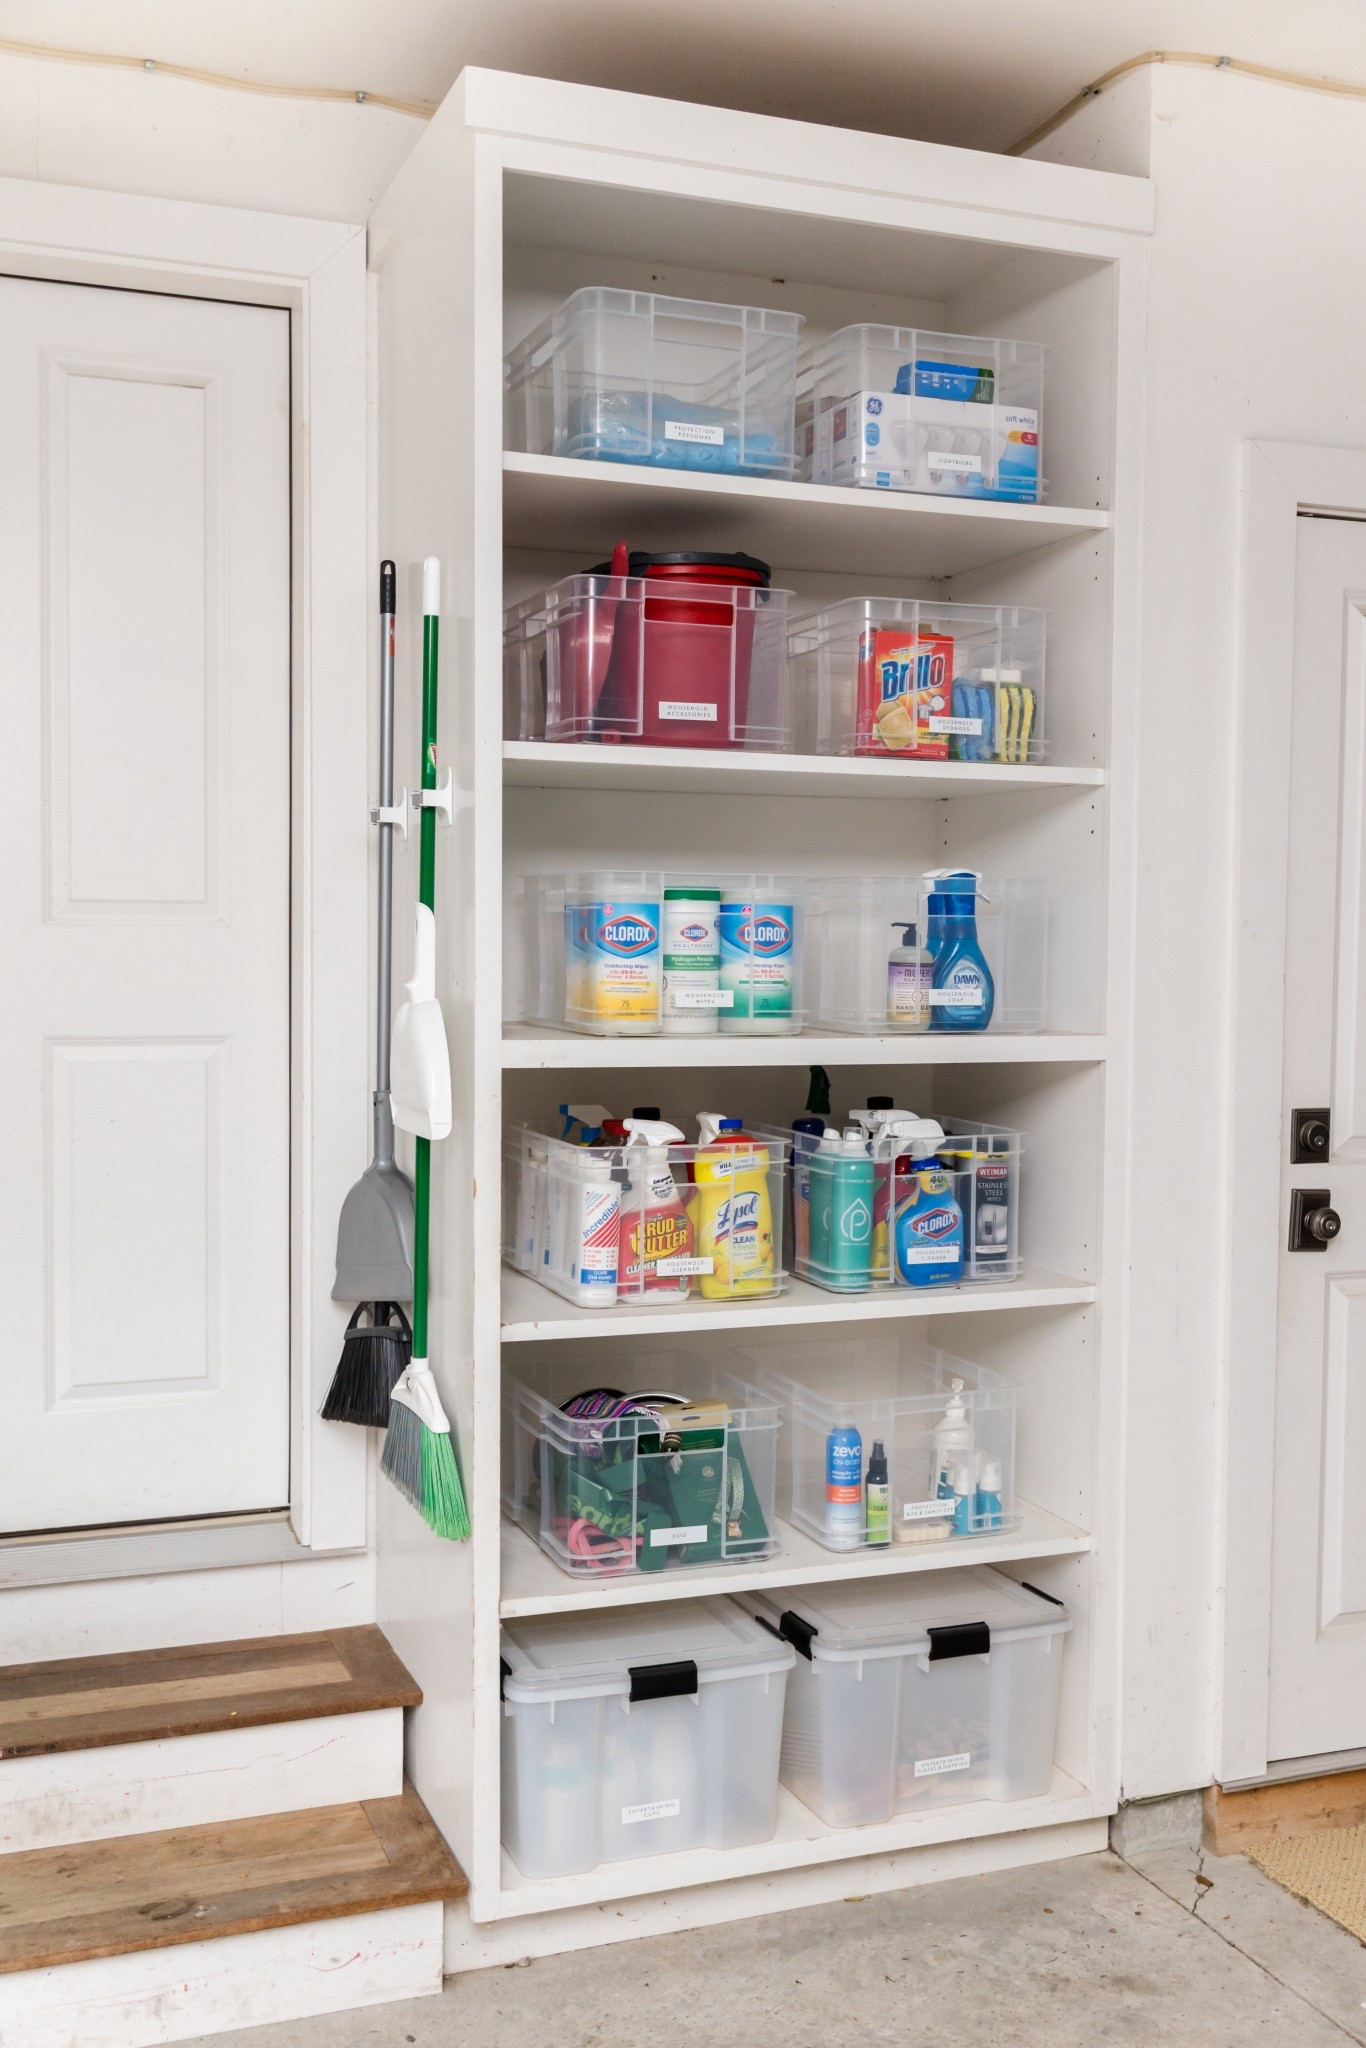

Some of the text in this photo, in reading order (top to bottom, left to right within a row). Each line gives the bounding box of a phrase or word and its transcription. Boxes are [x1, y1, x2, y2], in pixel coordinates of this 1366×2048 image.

[1005, 415, 1035, 425] soft white
[674, 425, 715, 435] PROTECTION
[678, 432, 711, 441] PERSONAL
[938, 458, 973, 466] LIGHTBULBS
[881, 653, 946, 703] Brillo
[605, 926, 650, 942] CLOROX
[744, 926, 786, 942] CLOROX
[954, 974, 980, 985] DAWN
[979, 1167, 1008, 1176] WEIMAN
[917, 1211, 955, 1235] CLOROX
[832, 1445, 861, 1458] zevo
